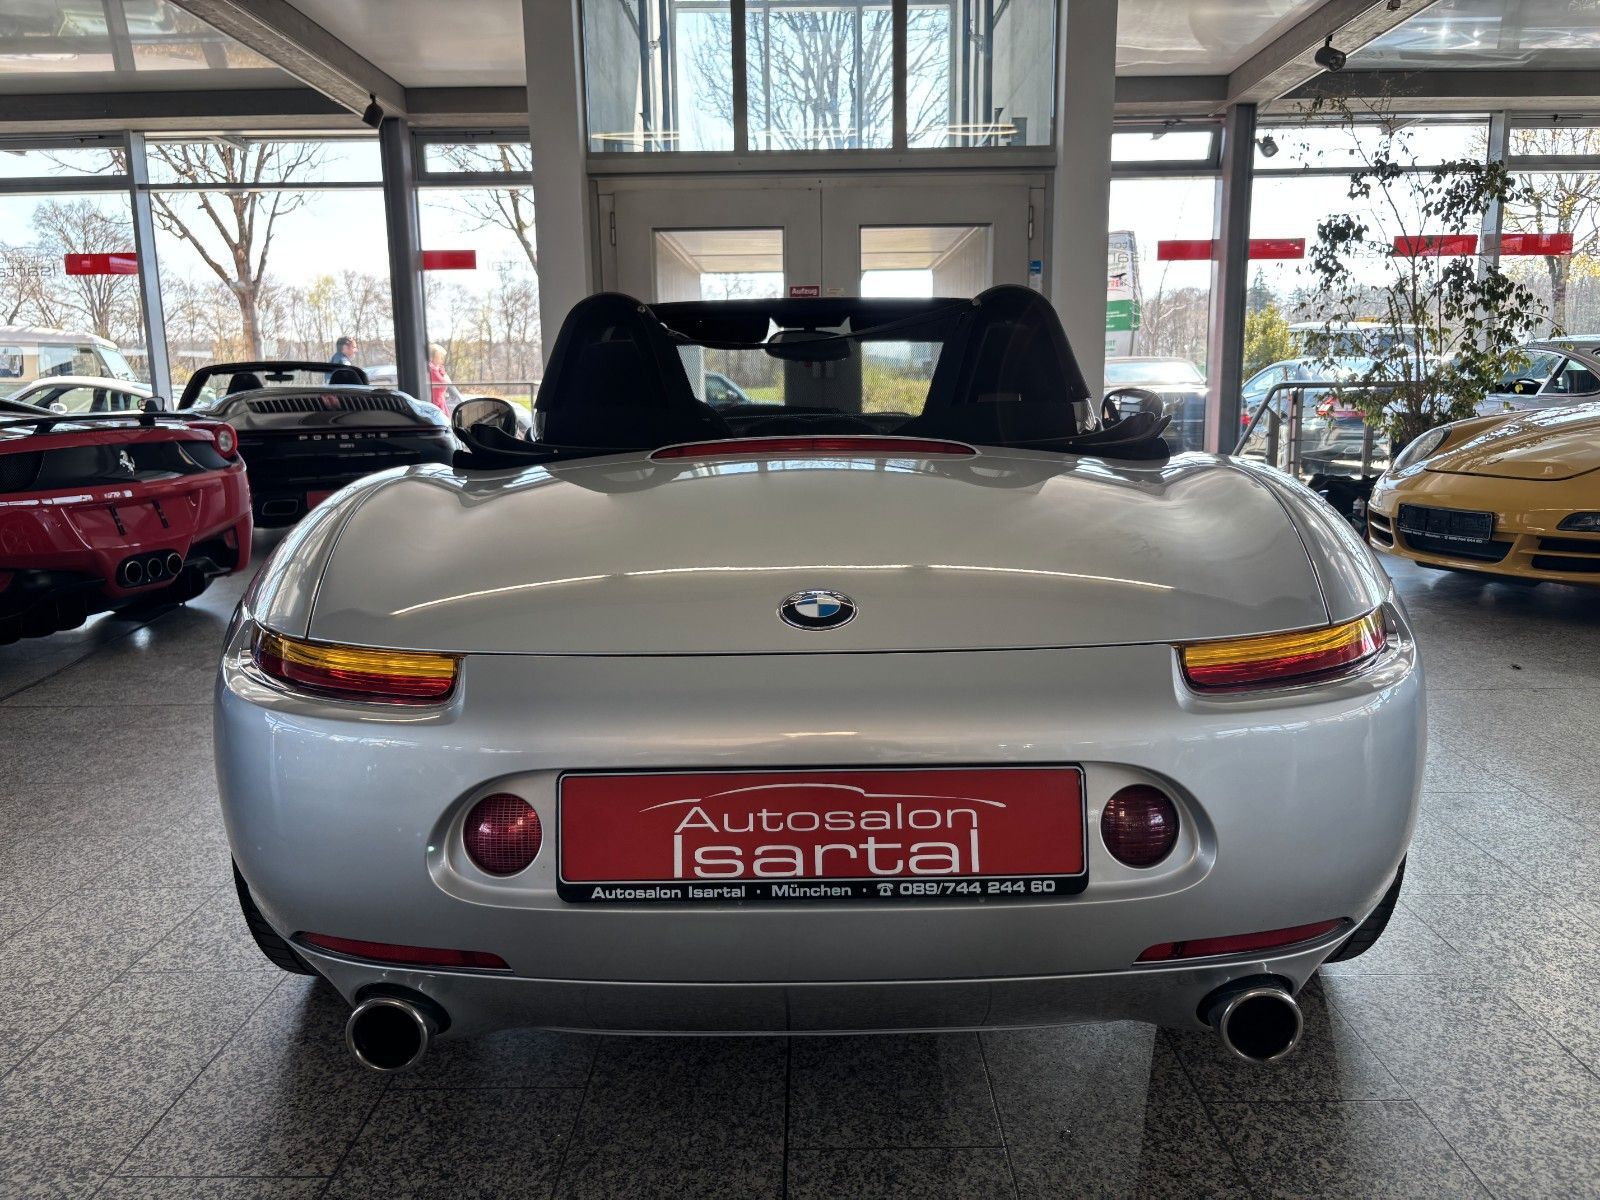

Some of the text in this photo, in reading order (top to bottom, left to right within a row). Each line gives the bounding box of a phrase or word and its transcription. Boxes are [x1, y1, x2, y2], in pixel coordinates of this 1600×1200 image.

[791, 287, 818, 296] Aufzug
[299, 433, 389, 441] PORSCHE
[674, 803, 978, 833] Autosalon
[673, 829, 980, 878] Isartal
[591, 880, 1056, 899] Autosalon Isartal München 089/744 244 60
